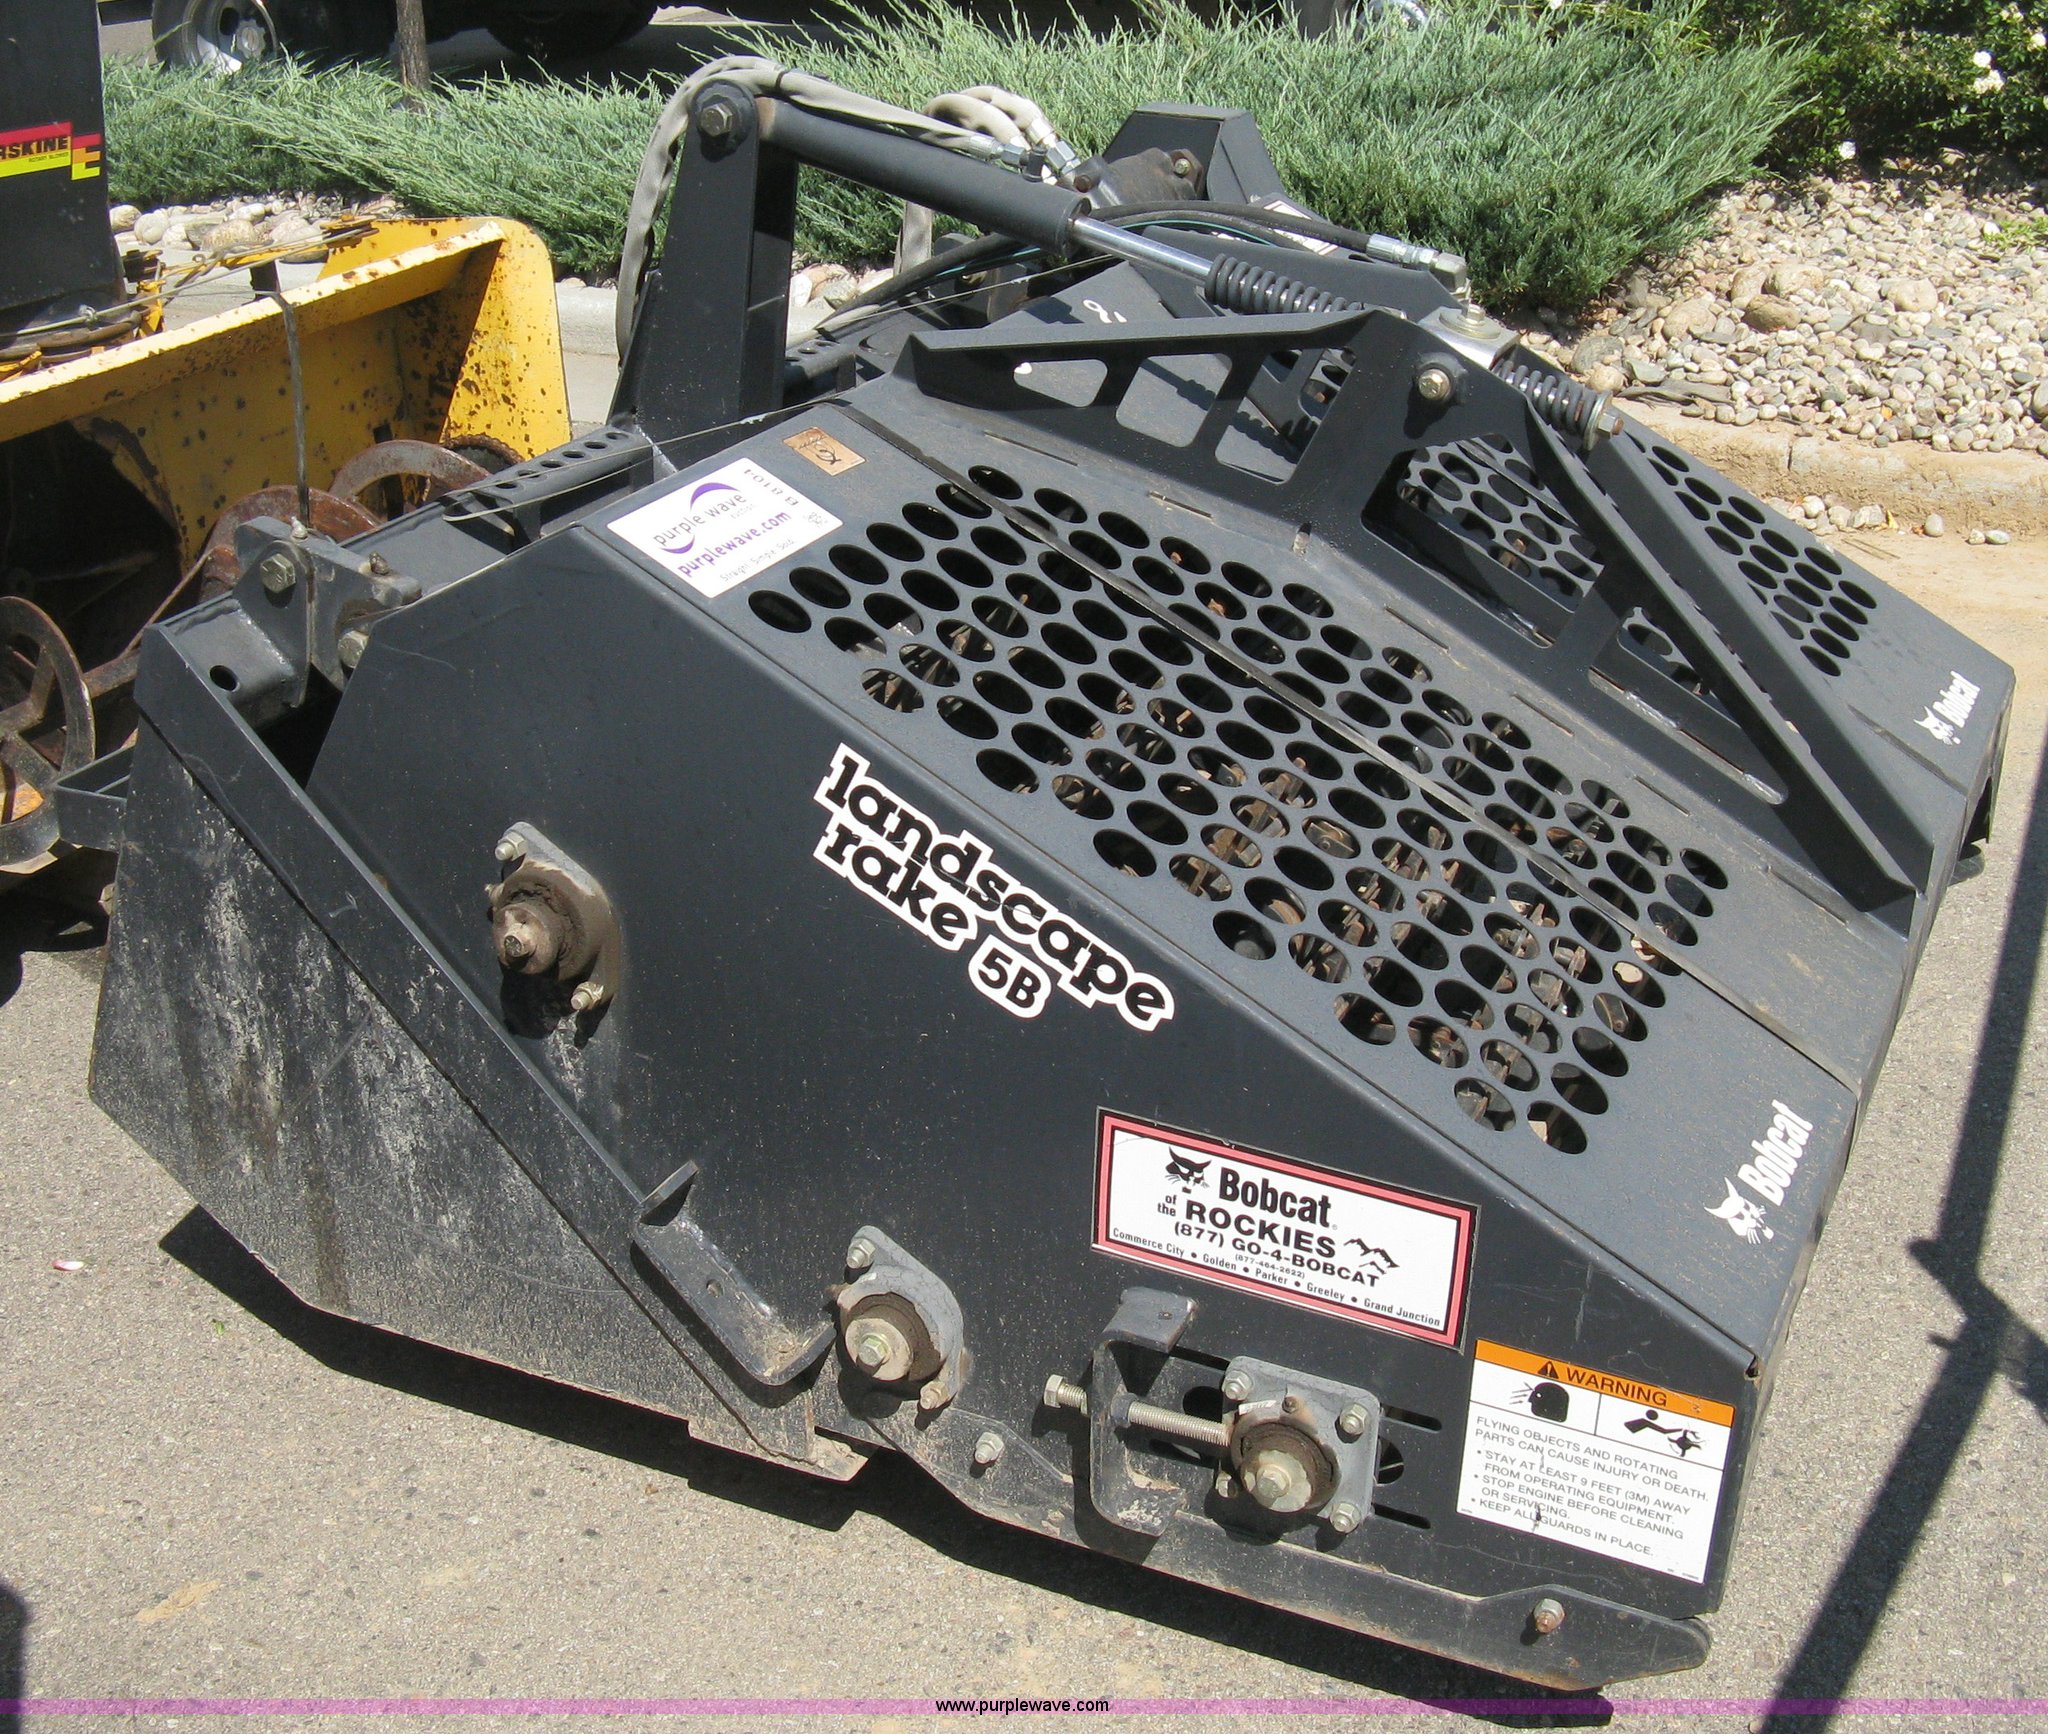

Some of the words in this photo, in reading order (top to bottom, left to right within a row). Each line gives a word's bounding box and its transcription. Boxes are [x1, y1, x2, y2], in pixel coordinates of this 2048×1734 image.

[653, 514, 706, 547] purple
[704, 494, 747, 517] wave
[677, 511, 792, 578] purplewave.com
[1932, 670, 1980, 728] Bobcat
[822, 752, 1170, 1024] landscape
[822, 820, 970, 943] rake
[976, 946, 1044, 1011] 5B
[1737, 1099, 1814, 1206] Bobcat
[1157, 1203, 1177, 1217] the
[1186, 1199, 1336, 1259] ROCKIES
[1165, 1194, 1177, 1205] of
[1219, 1166, 1332, 1228] Bobcat
[1113, 1227, 1163, 1250] Commerce
[1166, 1243, 1185, 1258] City
[1203, 1253, 1237, 1271] Golden
[1255, 1267, 1288, 1285] Parker
[1306, 1282, 1345, 1301] Greeley
[1364, 1298, 1393, 1314] Grand
[1396, 1307, 1440, 1327] Junction
[1175, 1221, 1225, 1248] (877)
[1231, 1238, 1380, 1288] GO-4-BOBCAT
[1566, 1367, 1667, 1407] WARNING
[1475, 1428, 1515, 1447] PARTS
[1518, 1440, 1544, 1456] CAN
[1547, 1449, 1590, 1468] CAUSE
[1593, 1461, 1639, 1481] INJURY
[1642, 1475, 1661, 1488] OR
[1664, 1481, 1709, 1502] DEATH.
[1476, 1416, 1520, 1436] FLYING
[1523, 1429, 1580, 1452] OBJECTS
[1583, 1446, 1610, 1460] AND
[1614, 1454, 1678, 1480] ROTATING
[1481, 1487, 1500, 1499] OR
[1482, 1474, 1515, 1490] STOP
[1518, 1484, 1564, 1505] ENGINE
[1567, 1499, 1617, 1521] BEFORE
[1620, 1514, 1684, 1540] CLEANING
[1485, 1450, 1516, 1466] STAY
[1519, 1460, 1536, 1471] AT
[1539, 1465, 1578, 1483] LEAST
[1580, 1477, 1588, 1487] 9
[1591, 1480, 1622, 1496] FEET
[1625, 1490, 1650, 1506] (3M)
[1653, 1498, 1691, 1515] AWAY
[1485, 1462, 1520, 1480] FROM
[1523, 1474, 1595, 1502] OPERATING
[1598, 1495, 1675, 1524] EQUIPMENT.
[1480, 1498, 1511, 1513] KEEP
[1513, 1508, 1537, 1522] ALL
[1540, 1515, 1591, 1538] GUARDS
[1594, 1531, 1607, 1542] IN
[1610, 1536, 1654, 1556] PLACE.
